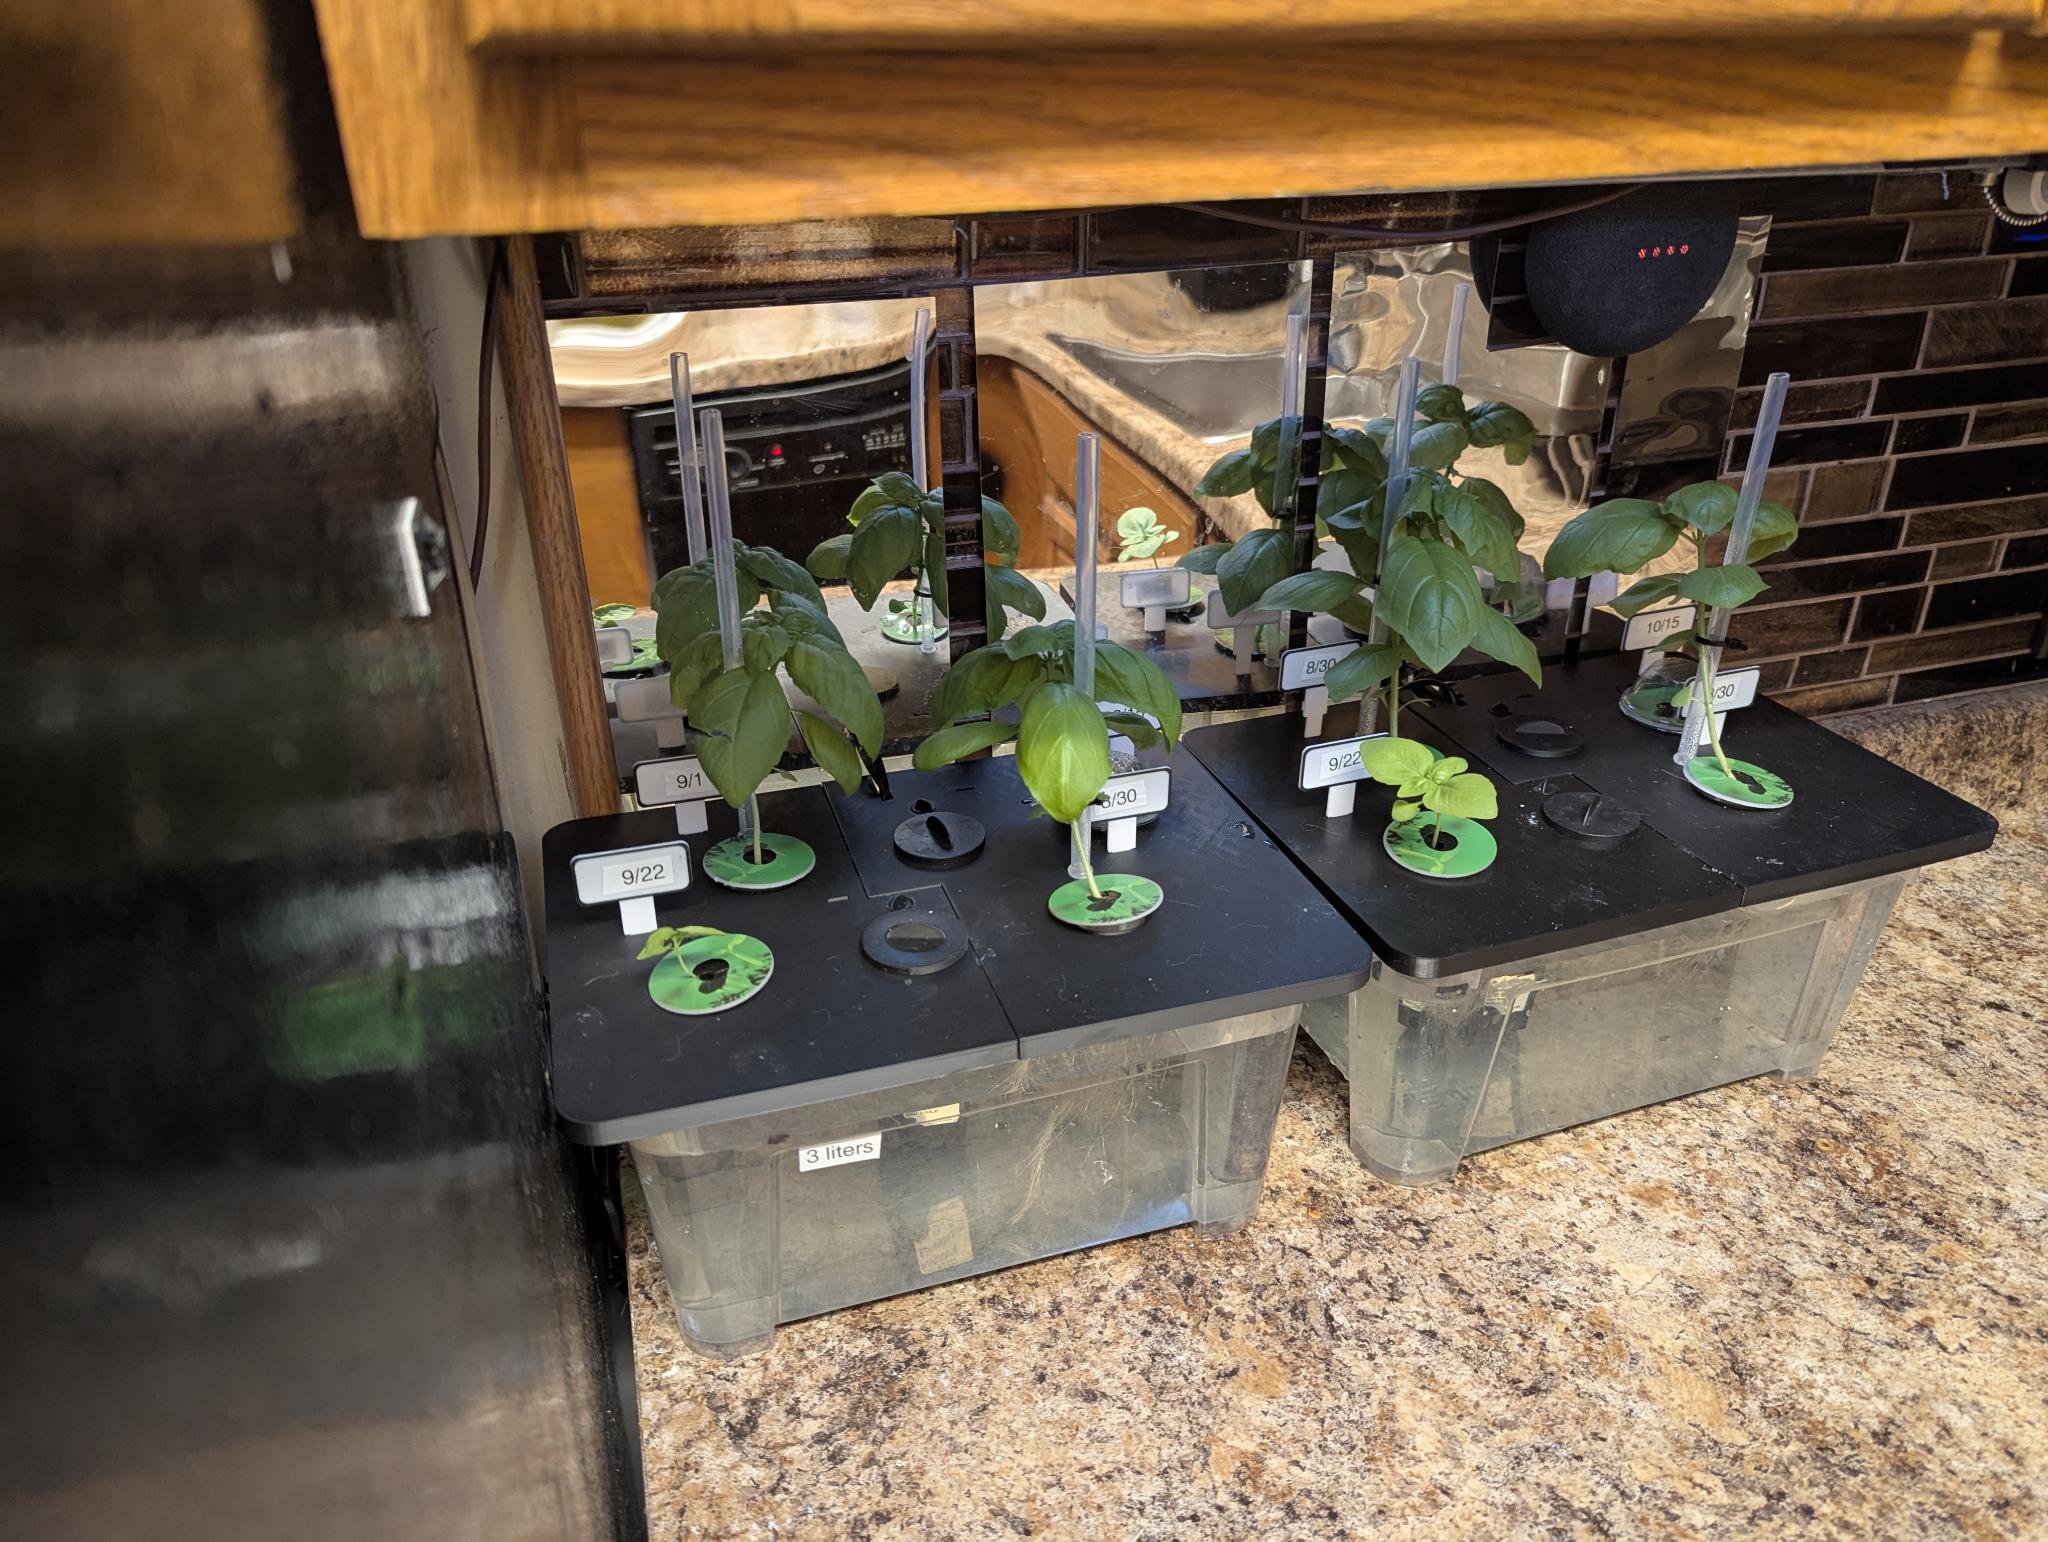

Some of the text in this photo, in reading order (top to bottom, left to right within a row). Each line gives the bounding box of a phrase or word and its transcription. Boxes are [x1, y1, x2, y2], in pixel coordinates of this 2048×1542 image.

[1646, 616, 1680, 634] 10/15
[1328, 751, 1361, 771] 9/22
[676, 772, 702, 789] 9/1
[621, 864, 666, 886] 9/22
[806, 1141, 875, 1164] 3 liters
